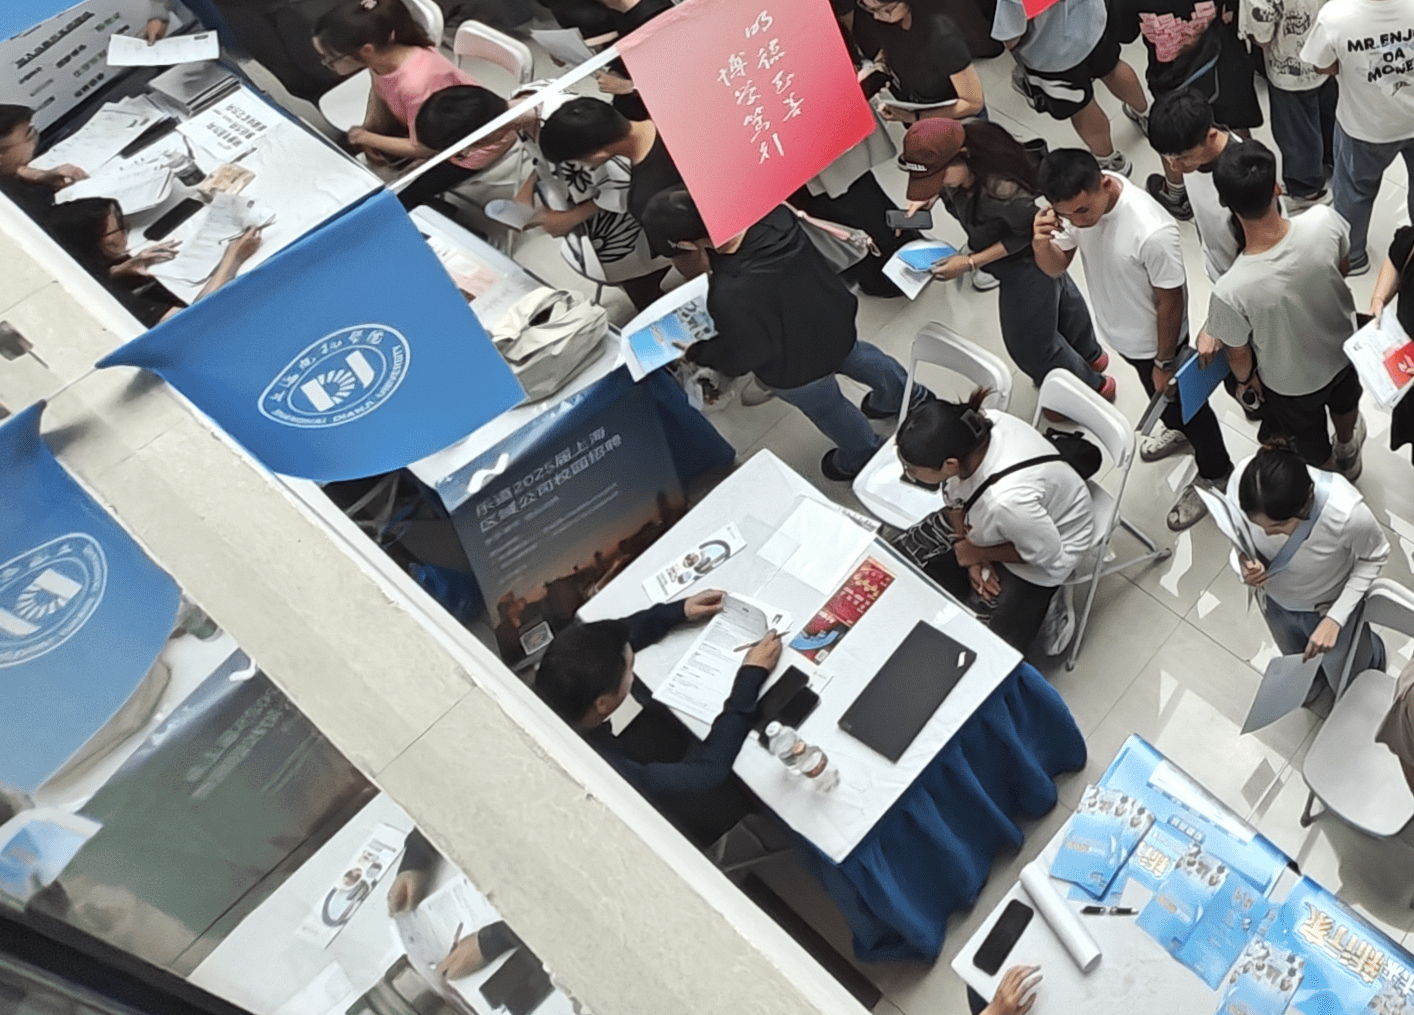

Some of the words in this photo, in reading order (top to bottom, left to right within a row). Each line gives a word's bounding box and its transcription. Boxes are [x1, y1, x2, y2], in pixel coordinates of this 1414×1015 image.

[717, 51, 786, 165] 博学笃行
[744, 10, 805, 122] 明德至善
